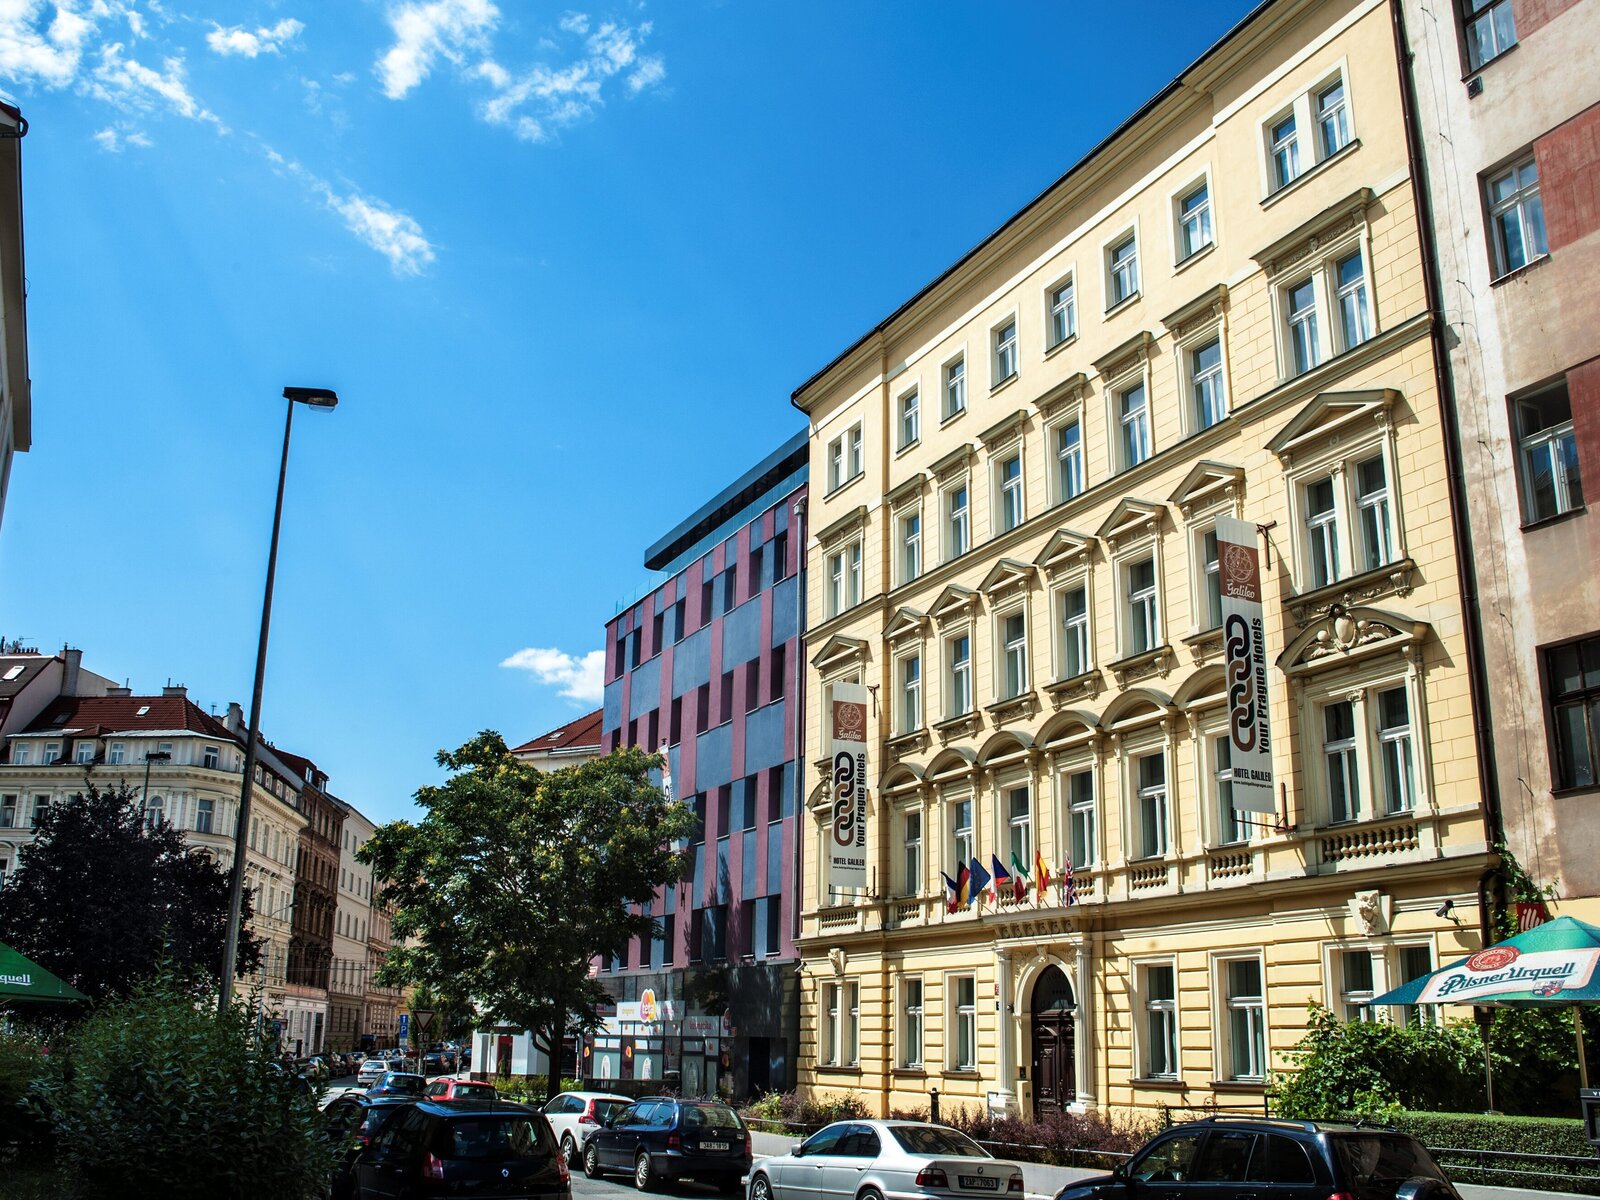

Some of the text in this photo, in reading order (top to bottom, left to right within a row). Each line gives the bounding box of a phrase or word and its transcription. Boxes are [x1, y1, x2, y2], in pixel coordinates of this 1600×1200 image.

[1227, 582, 1255, 599] Galileo
[1251, 617, 1270, 754] Your Prague Hotels
[838, 730, 862, 740] Galileo
[1233, 767, 1272, 782] HOTEL GALILEO
[856, 753, 866, 848] Your Prague Hotels
[833, 857, 846, 865] HOTEL
[1437, 962, 1576, 997] Pilsner Urquell
[400, 1025, 407, 1034] P
